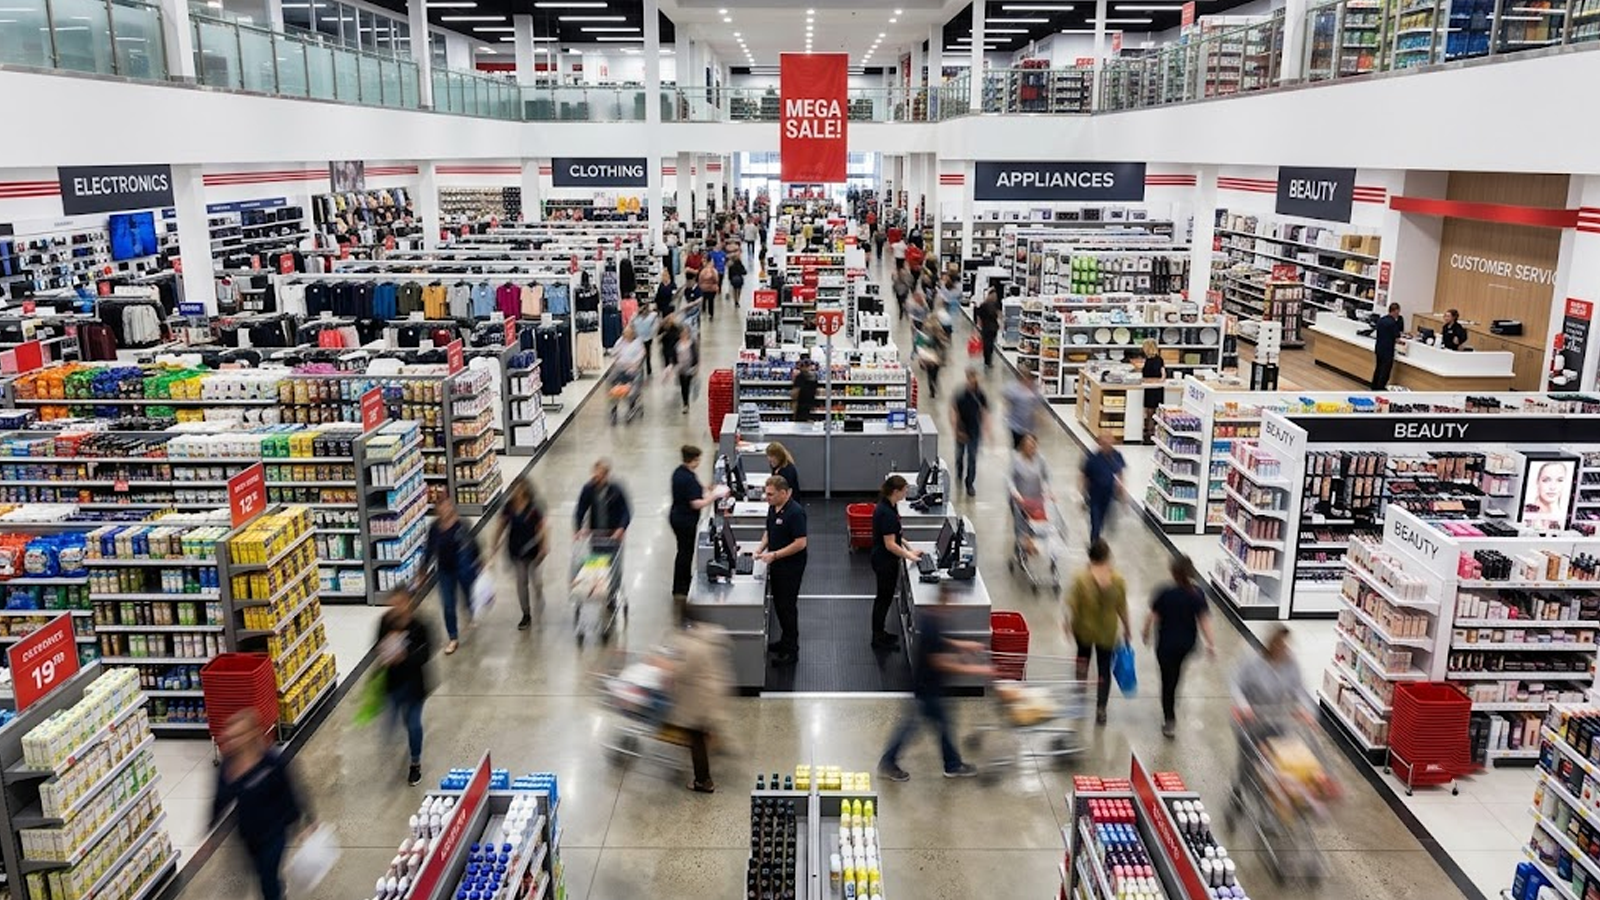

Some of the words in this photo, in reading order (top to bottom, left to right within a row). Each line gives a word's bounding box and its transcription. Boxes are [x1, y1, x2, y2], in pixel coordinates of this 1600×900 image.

[785, 99, 842, 118] MEGA
[785, 119, 842, 139] SALE!
[569, 164, 644, 178] CLOTHING
[996, 172, 1115, 188] APPLIANCES
[73, 174, 169, 196] ELECTRONICS
[1289, 179, 1337, 201] BEAUTY
[1450, 253, 1513, 277] CUSTOMER
[1394, 422, 1469, 438] BEAUTY
[1394, 520, 1439, 560] BEAUTY
